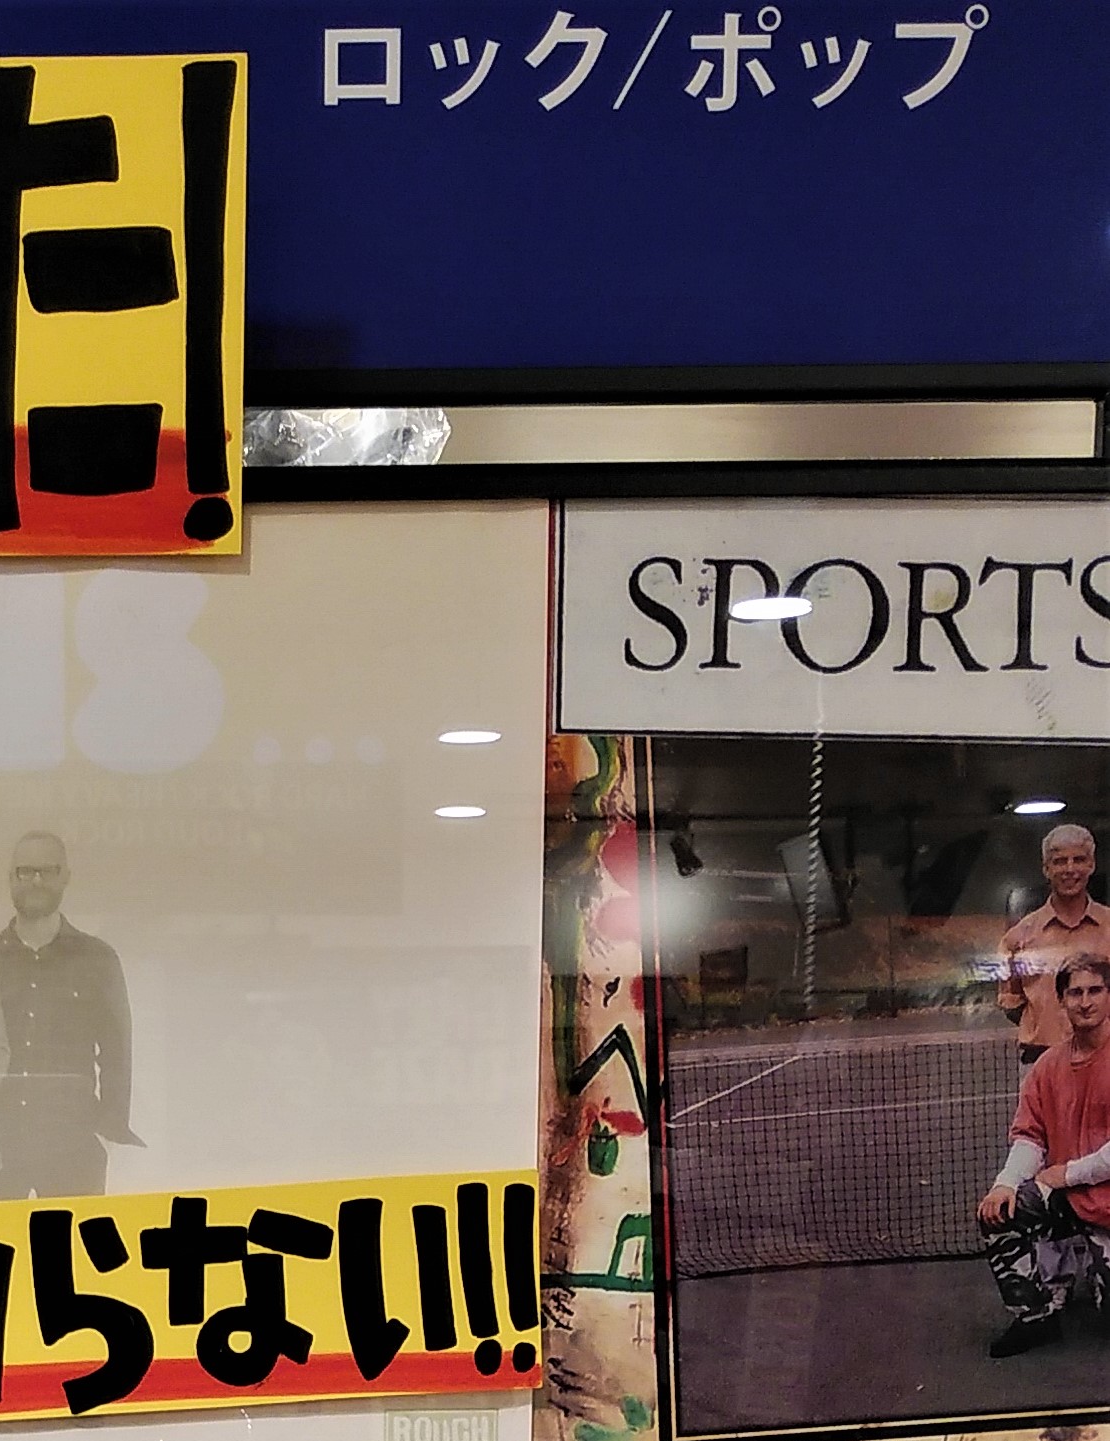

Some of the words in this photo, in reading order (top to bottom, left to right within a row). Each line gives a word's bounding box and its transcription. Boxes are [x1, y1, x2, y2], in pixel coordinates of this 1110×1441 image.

[323, 3, 989, 111] ロック/ポップ
